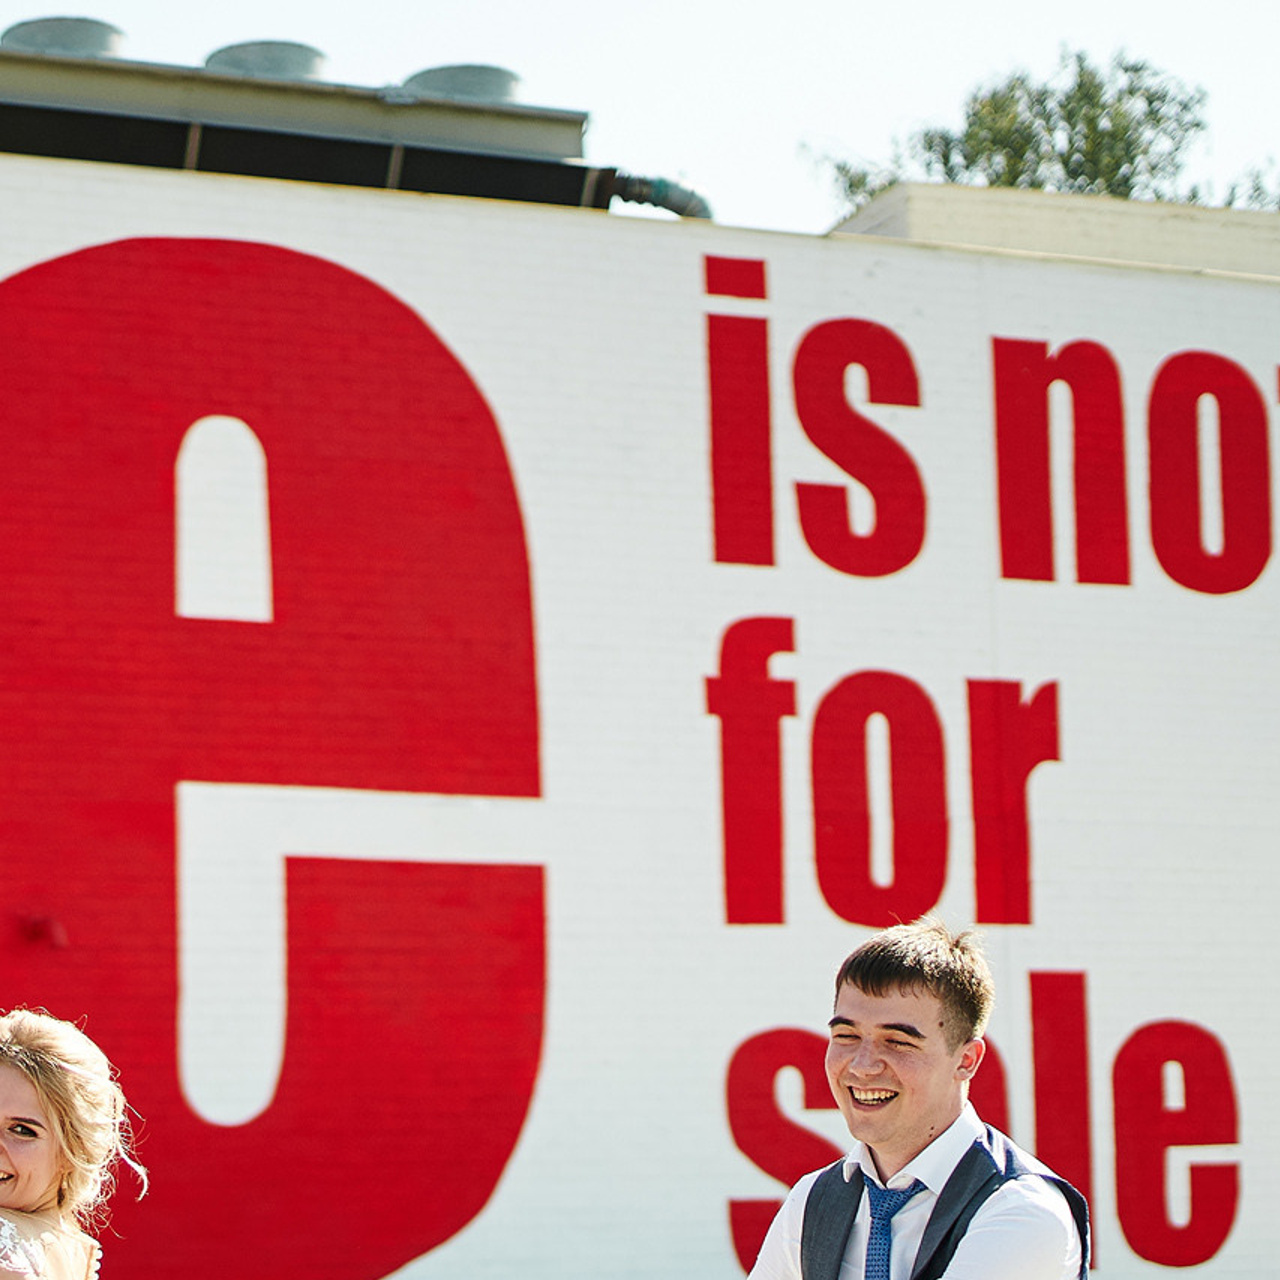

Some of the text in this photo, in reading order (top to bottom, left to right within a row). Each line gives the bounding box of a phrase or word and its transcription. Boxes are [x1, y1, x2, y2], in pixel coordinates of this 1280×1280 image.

[703, 254, 1280, 596] is no
[704, 616, 1063, 930] for
